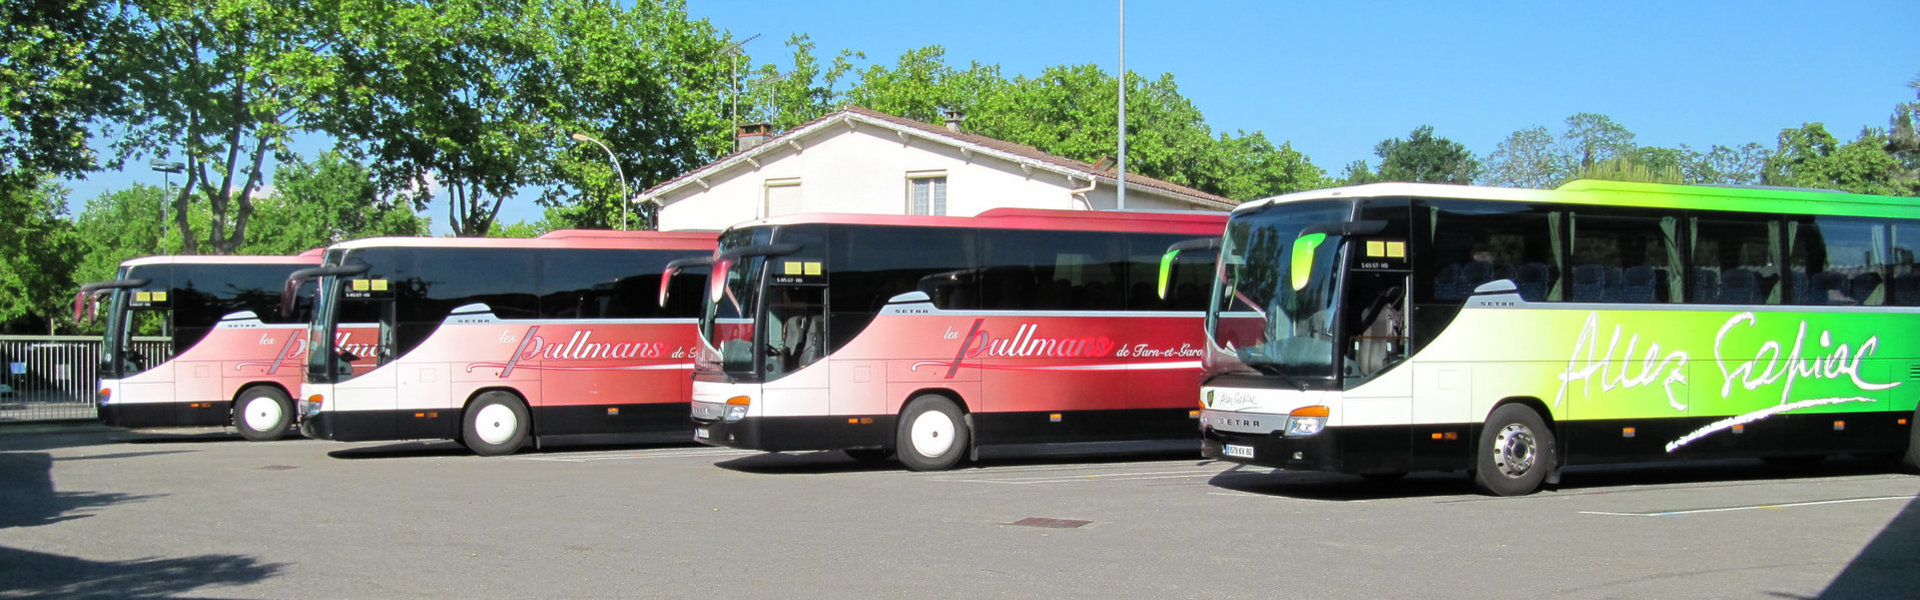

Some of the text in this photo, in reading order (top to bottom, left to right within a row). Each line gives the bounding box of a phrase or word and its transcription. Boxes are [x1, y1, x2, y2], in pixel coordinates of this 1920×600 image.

[499, 329, 517, 344] les
[671, 346, 685, 359] de
[943, 325, 959, 340] les
[1116, 343, 1130, 357] de
[1132, 343, 1204, 358] Tarn-et-Garo
[1554, 310, 1902, 411] Allez Sapiac
[1219, 418, 1260, 427] SETRA
